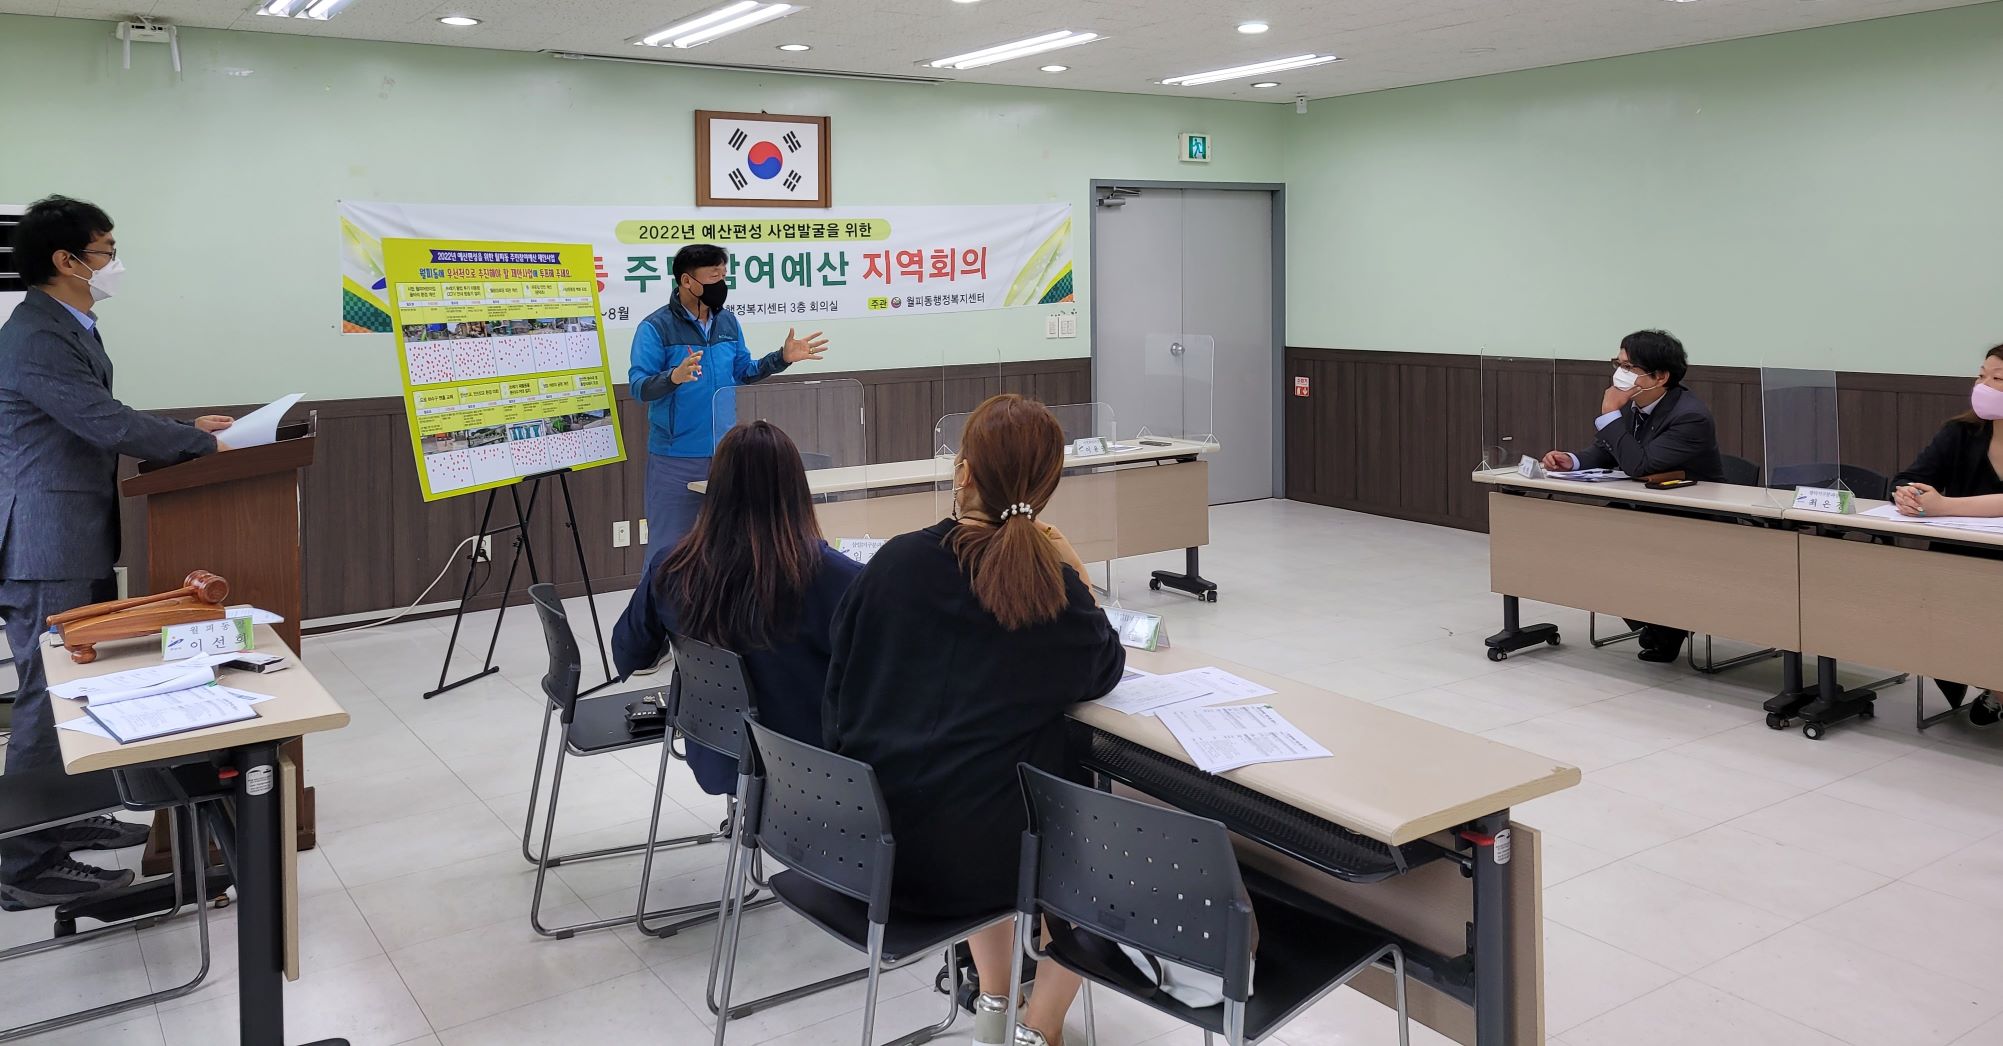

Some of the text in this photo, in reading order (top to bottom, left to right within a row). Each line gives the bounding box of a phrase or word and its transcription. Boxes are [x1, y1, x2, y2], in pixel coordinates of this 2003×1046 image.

[639, 222, 872, 240] 2022년 예산편성 사업발굴을 위한
[437, 252, 457, 262] 2022년
[447, 268, 476, 279] 우선적으로
[862, 247, 987, 285] 지역회의
[790, 301, 806, 313] 3층
[809, 300, 838, 312] 회의실
[871, 292, 985, 309] 주관 월피동행정복지센터
